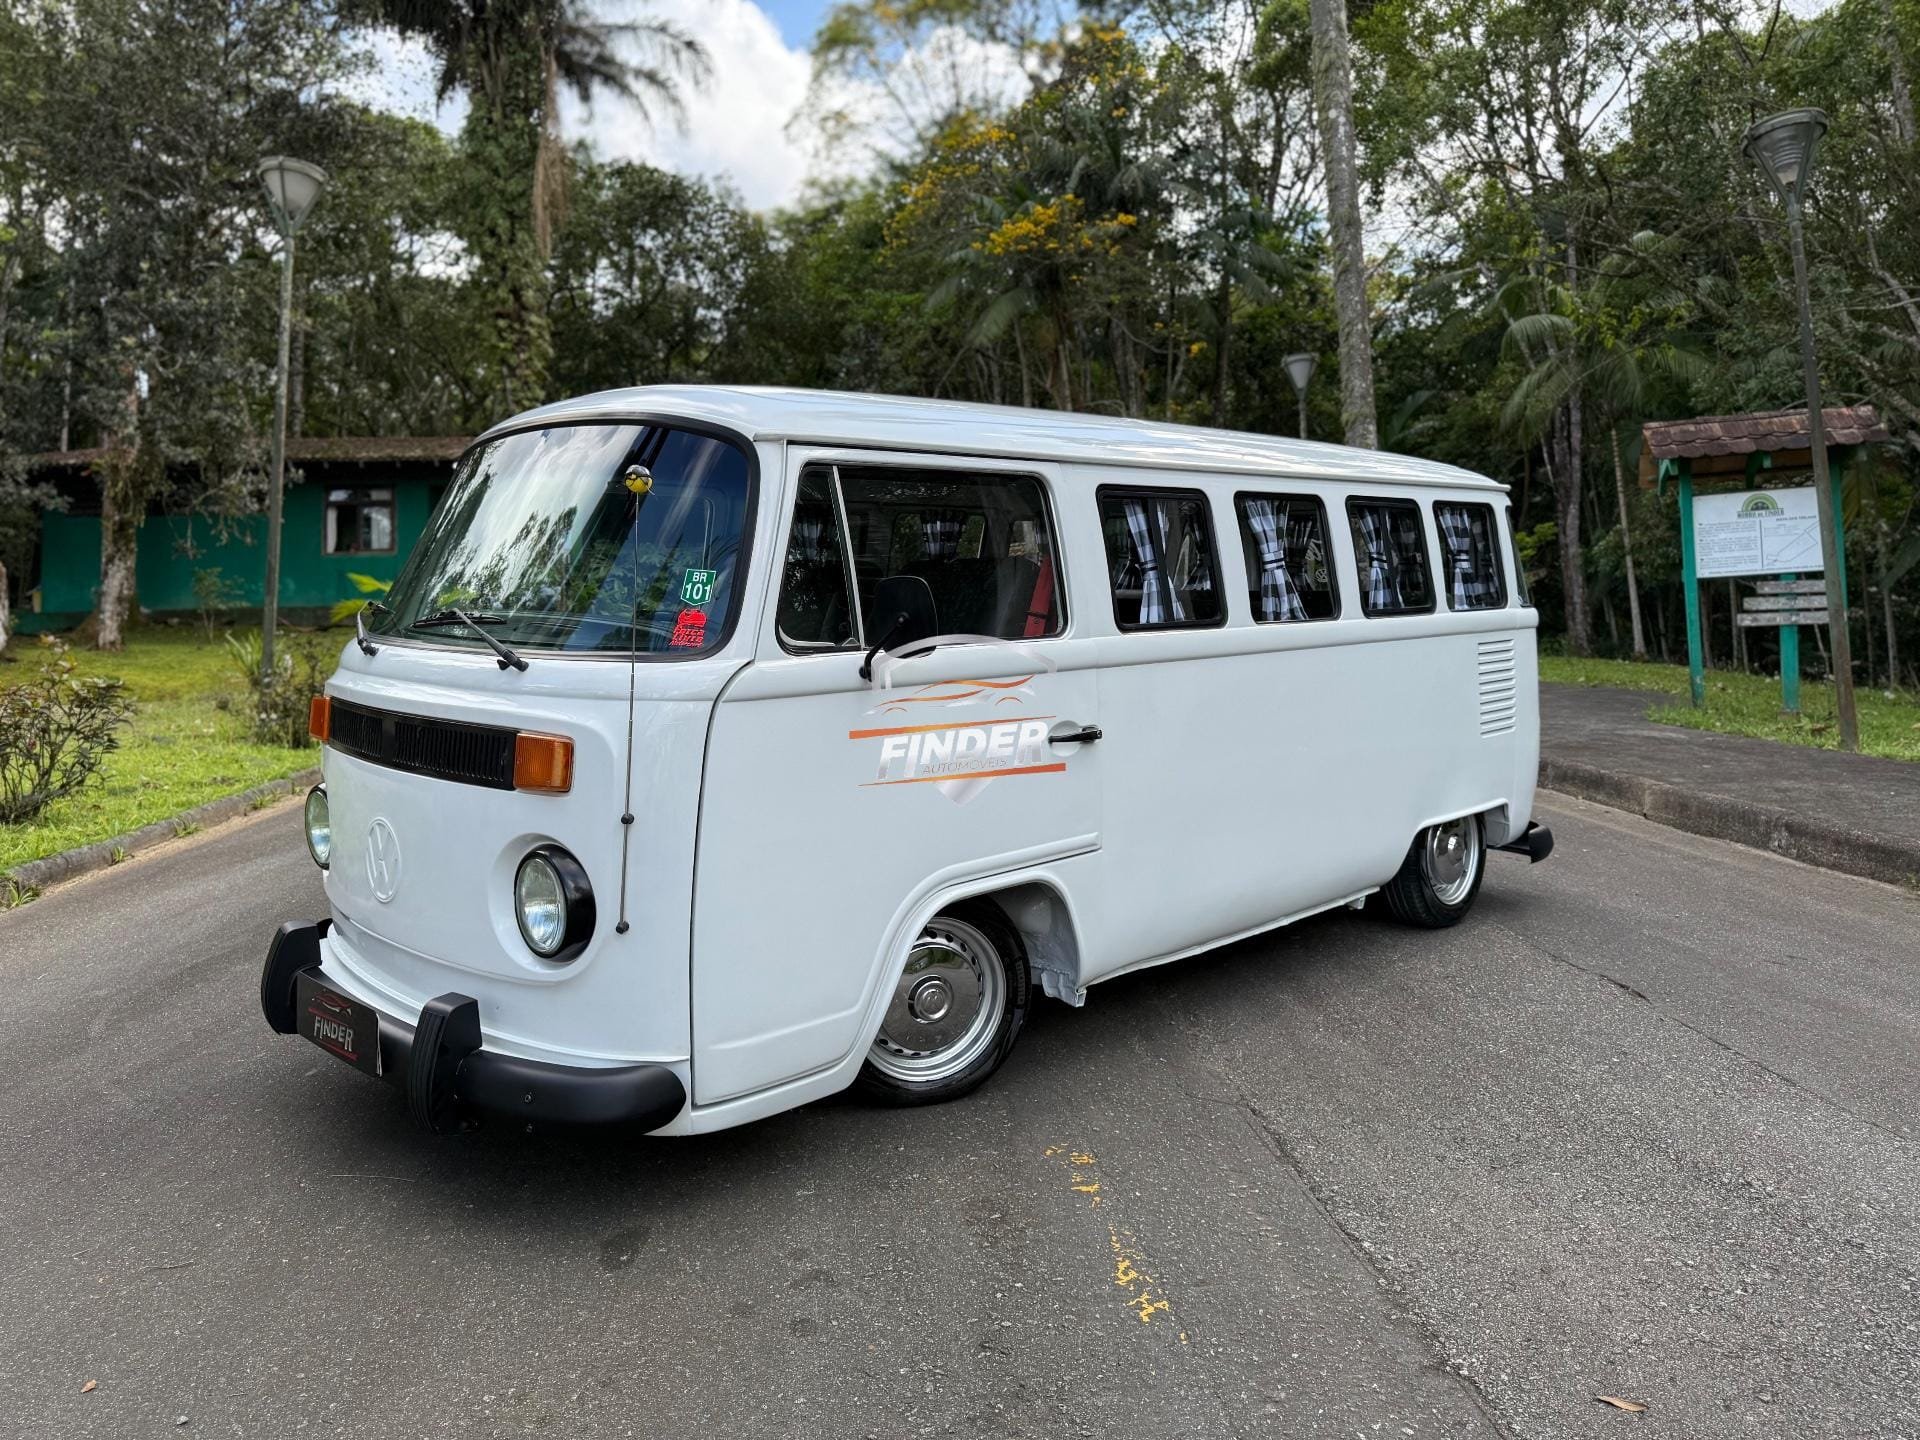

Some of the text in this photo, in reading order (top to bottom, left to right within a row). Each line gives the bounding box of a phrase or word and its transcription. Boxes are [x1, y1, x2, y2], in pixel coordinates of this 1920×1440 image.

[692, 572, 708, 583] BR
[685, 583, 711, 601] 101
[313, 1015, 354, 1053] FINDER
